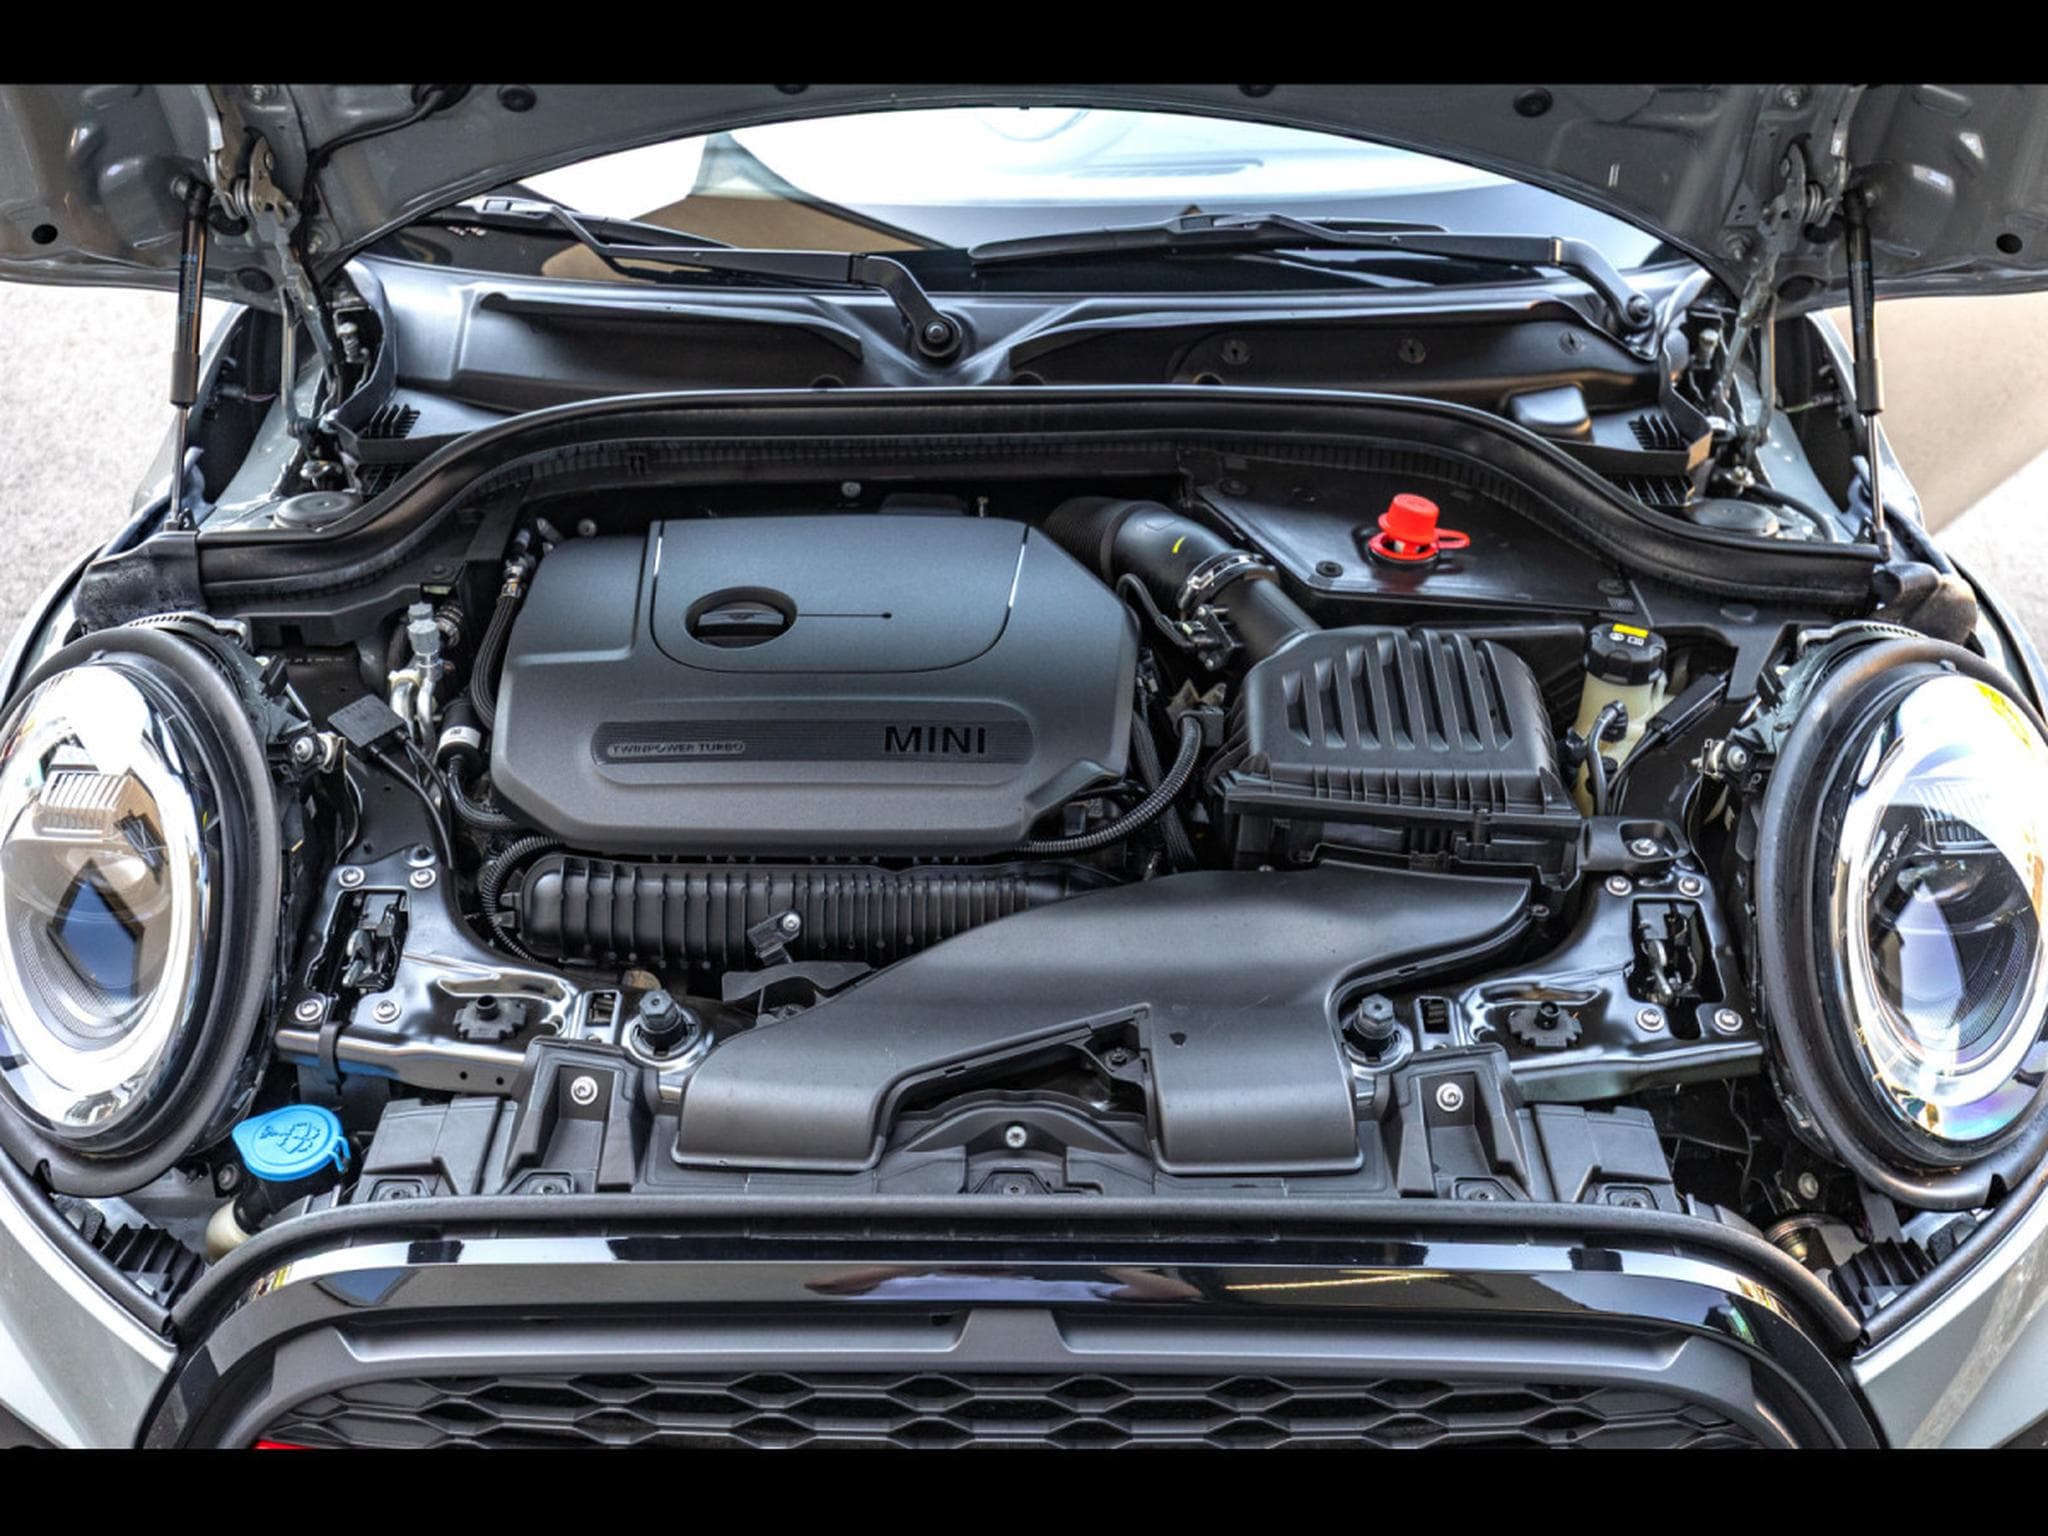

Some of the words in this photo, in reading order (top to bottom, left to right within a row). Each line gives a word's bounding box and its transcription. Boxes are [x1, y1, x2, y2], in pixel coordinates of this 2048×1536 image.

[611, 742, 695, 754] TWINPOWER
[700, 741, 743, 752] TURBO
[884, 725, 986, 754] MINI
